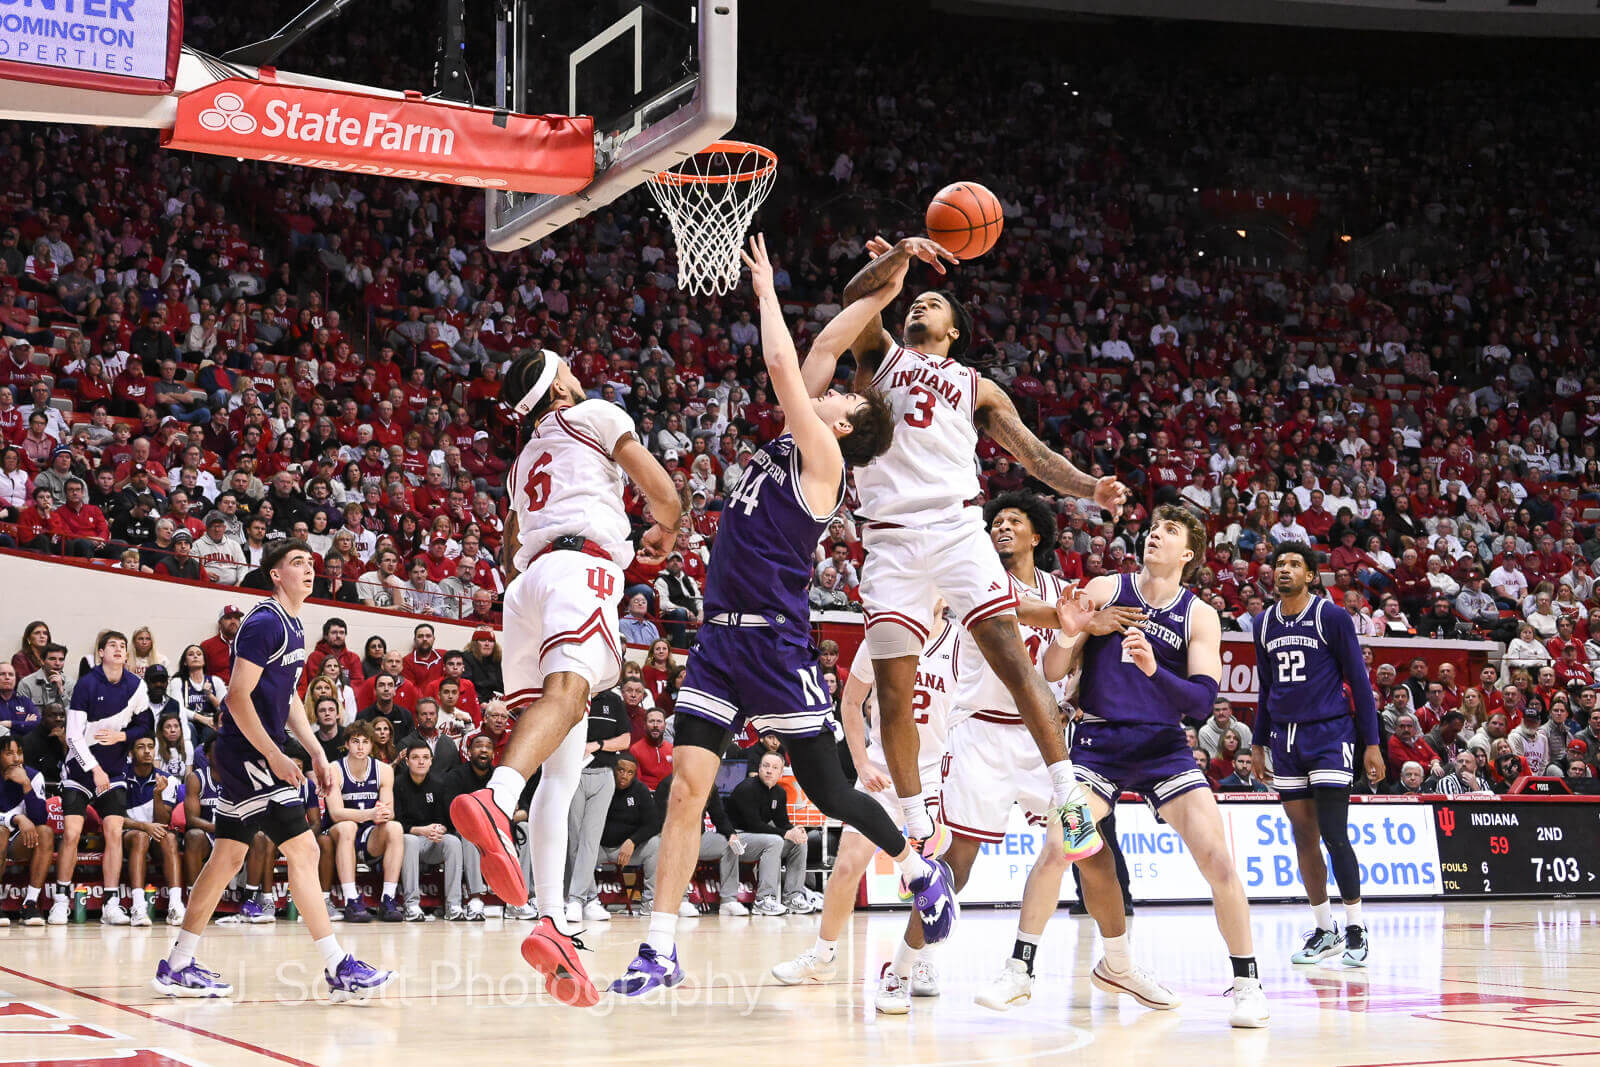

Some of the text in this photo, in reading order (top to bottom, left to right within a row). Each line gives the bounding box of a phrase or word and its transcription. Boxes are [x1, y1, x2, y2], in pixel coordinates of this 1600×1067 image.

[0, 14, 135, 49] OMINGTON
[890, 368, 962, 411] INDIANA
[904, 385, 936, 429] 3
[524, 452, 553, 513] 6
[728, 464, 769, 516] 44
[1266, 635, 1319, 654] NORTHWESTERN
[1276, 650, 1307, 682] 22
[797, 665, 828, 706] N
[911, 689, 931, 724] 2
[1342, 742, 1355, 770] N
[1383, 817, 1417, 846] to
[1471, 813, 1519, 827] INDIANA
[1536, 826, 1563, 842] 2ND
[1490, 836, 1510, 855] 59
[1247, 856, 1264, 887] 5
[1441, 861, 1489, 875] FOULS 6
[1530, 857, 1581, 883] 7:03
[1444, 879, 1492, 893] TOL 2
